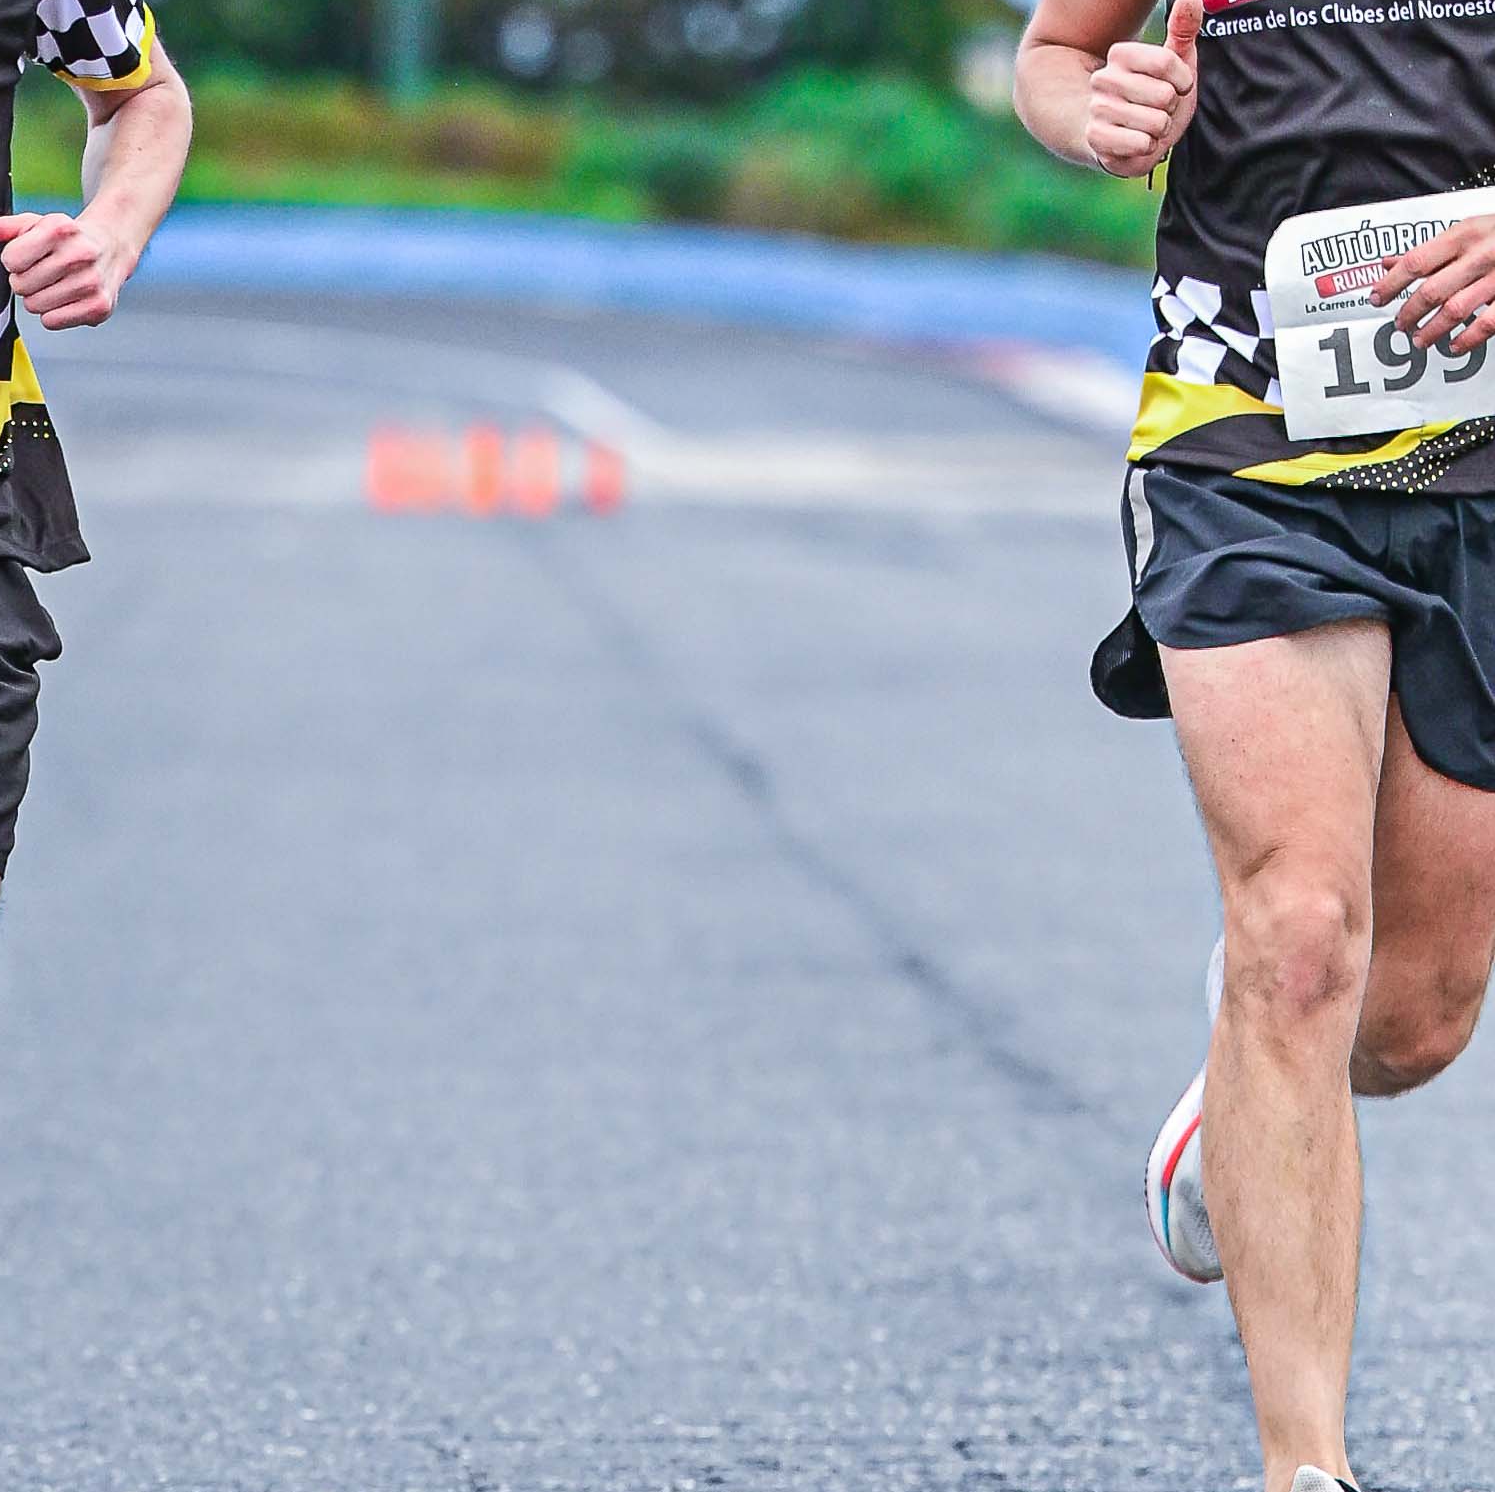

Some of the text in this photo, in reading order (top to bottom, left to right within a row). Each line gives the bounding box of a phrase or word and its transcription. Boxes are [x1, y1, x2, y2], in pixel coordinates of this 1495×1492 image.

[1206, 15, 1263, 37] Carrera
[1265, 10, 1286, 29] de
[1290, 7, 1317, 27] los
[1321, 4, 1385, 24] Clubes
[1388, 0, 1414, 21] del
[1301, 219, 1461, 276] AUTÓDRO
[1305, 304, 1317, 314] La
[1319, 297, 1355, 312] Carrera
